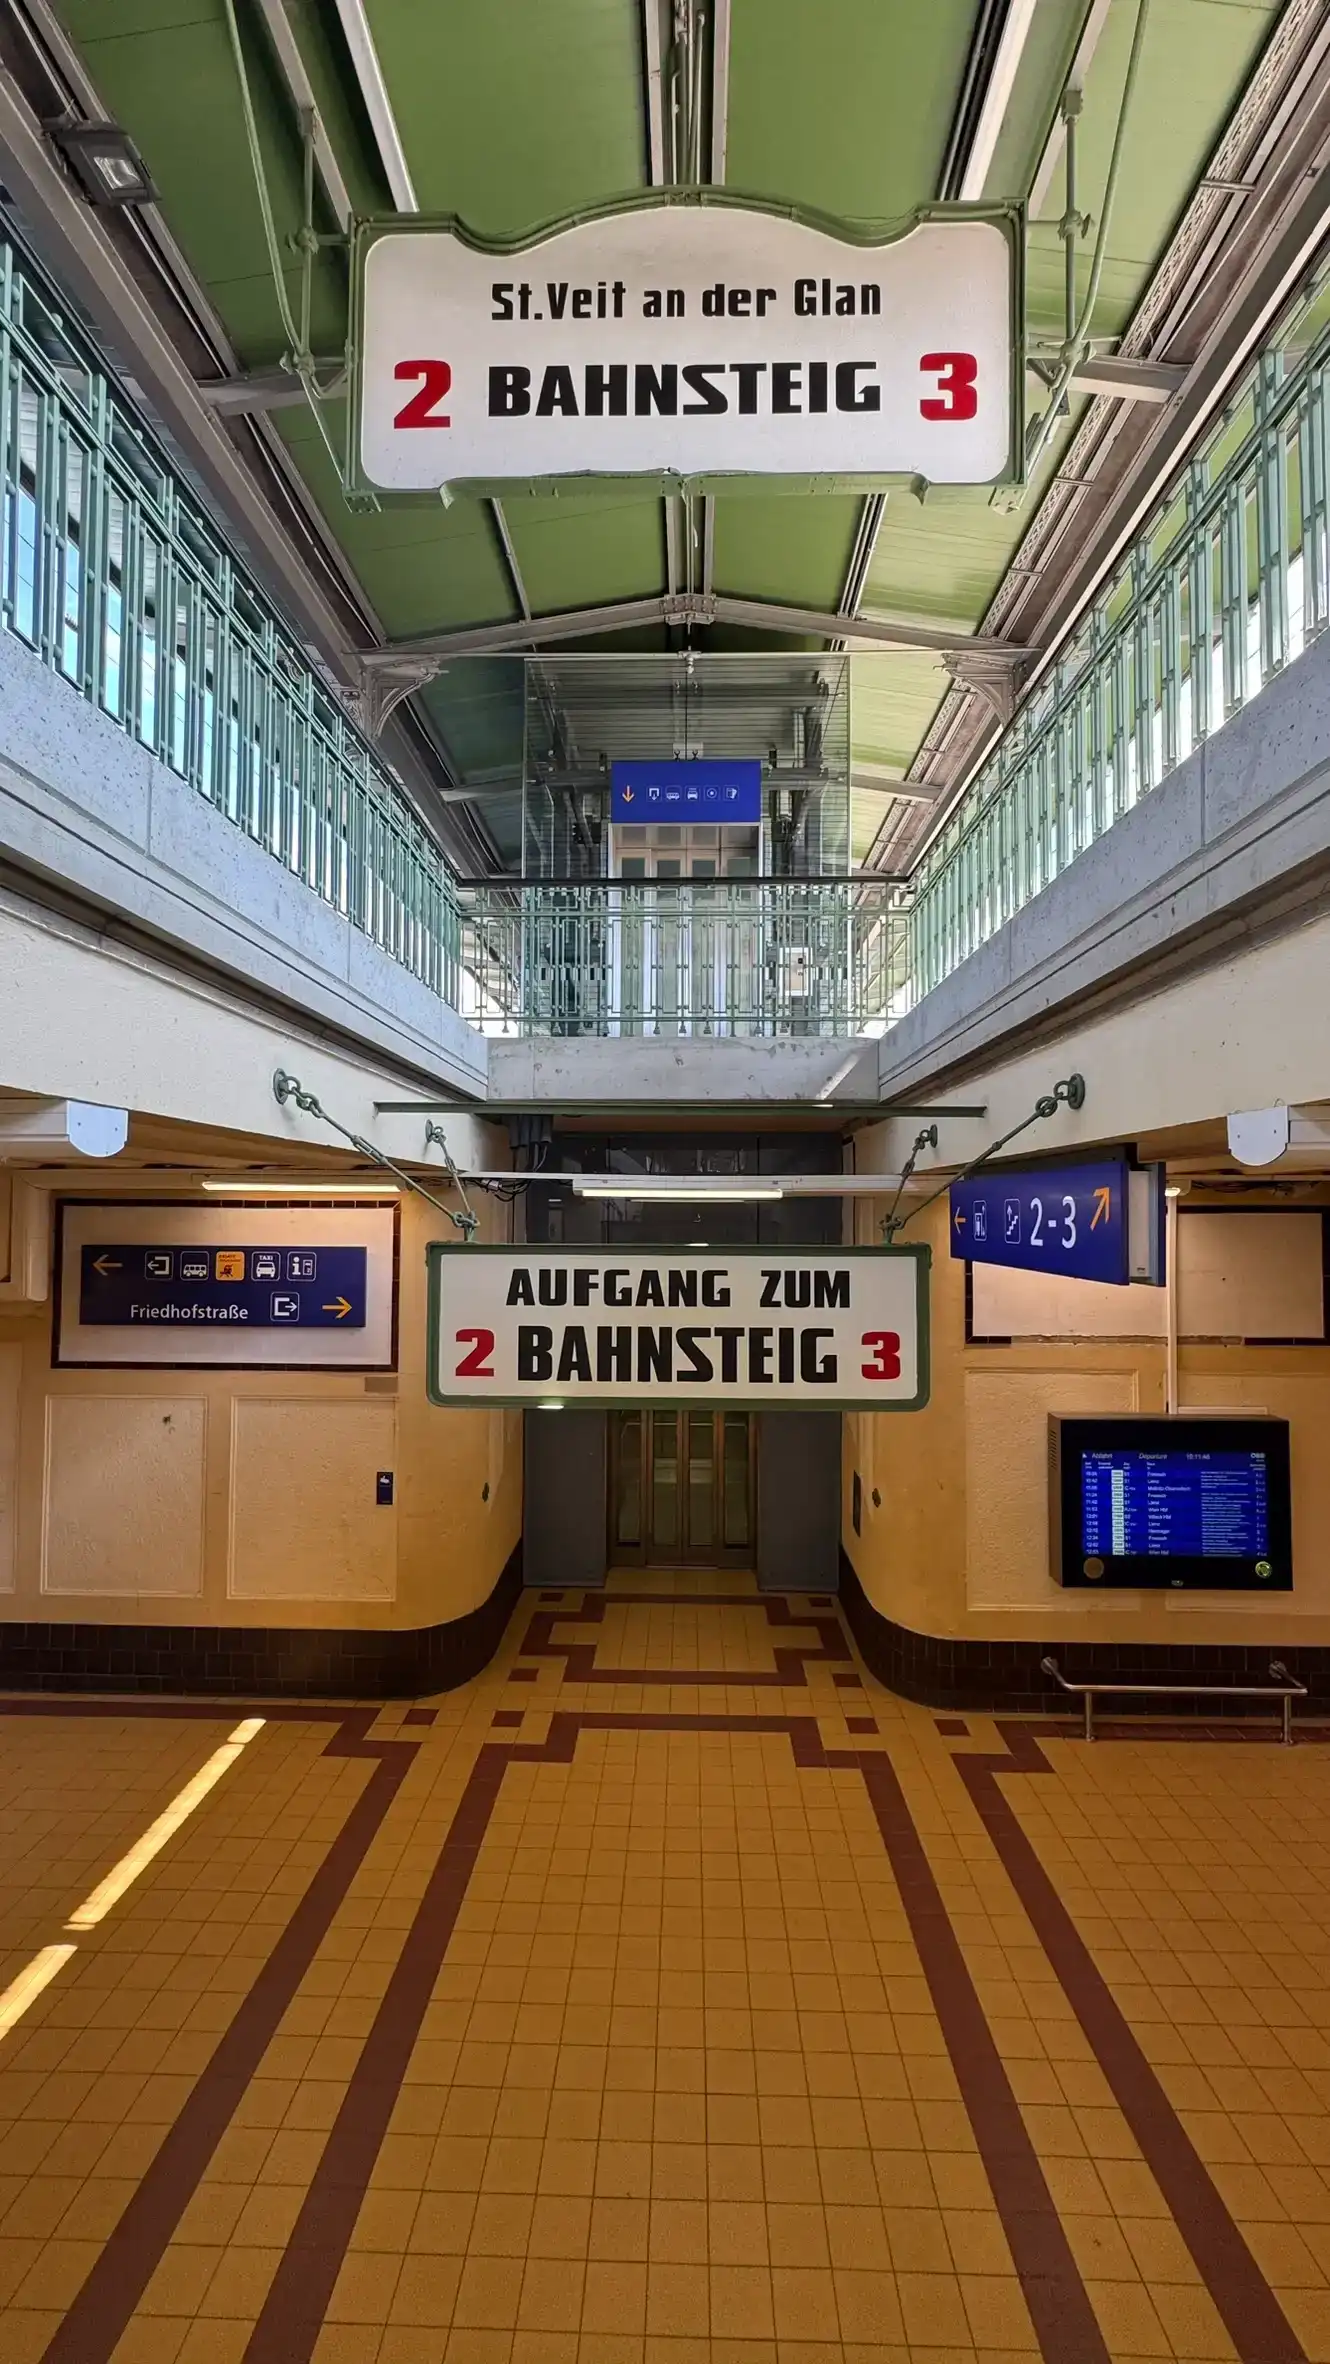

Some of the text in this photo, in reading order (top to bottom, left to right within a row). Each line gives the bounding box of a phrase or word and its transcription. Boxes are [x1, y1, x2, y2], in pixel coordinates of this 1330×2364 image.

[642, 290, 685, 318] an
[701, 283, 777, 317] der
[794, 278, 881, 317] Glan
[393, 352, 978, 430] 2 BAHNSTEIG 3
[505, 1268, 851, 1309] AUFGANG ZUM
[131, 1303, 249, 1320] Friedhofstraße
[455, 1325, 901, 1384] 2 BAHNSTEIG 3
[1138, 1452, 1168, 1460] Departure
